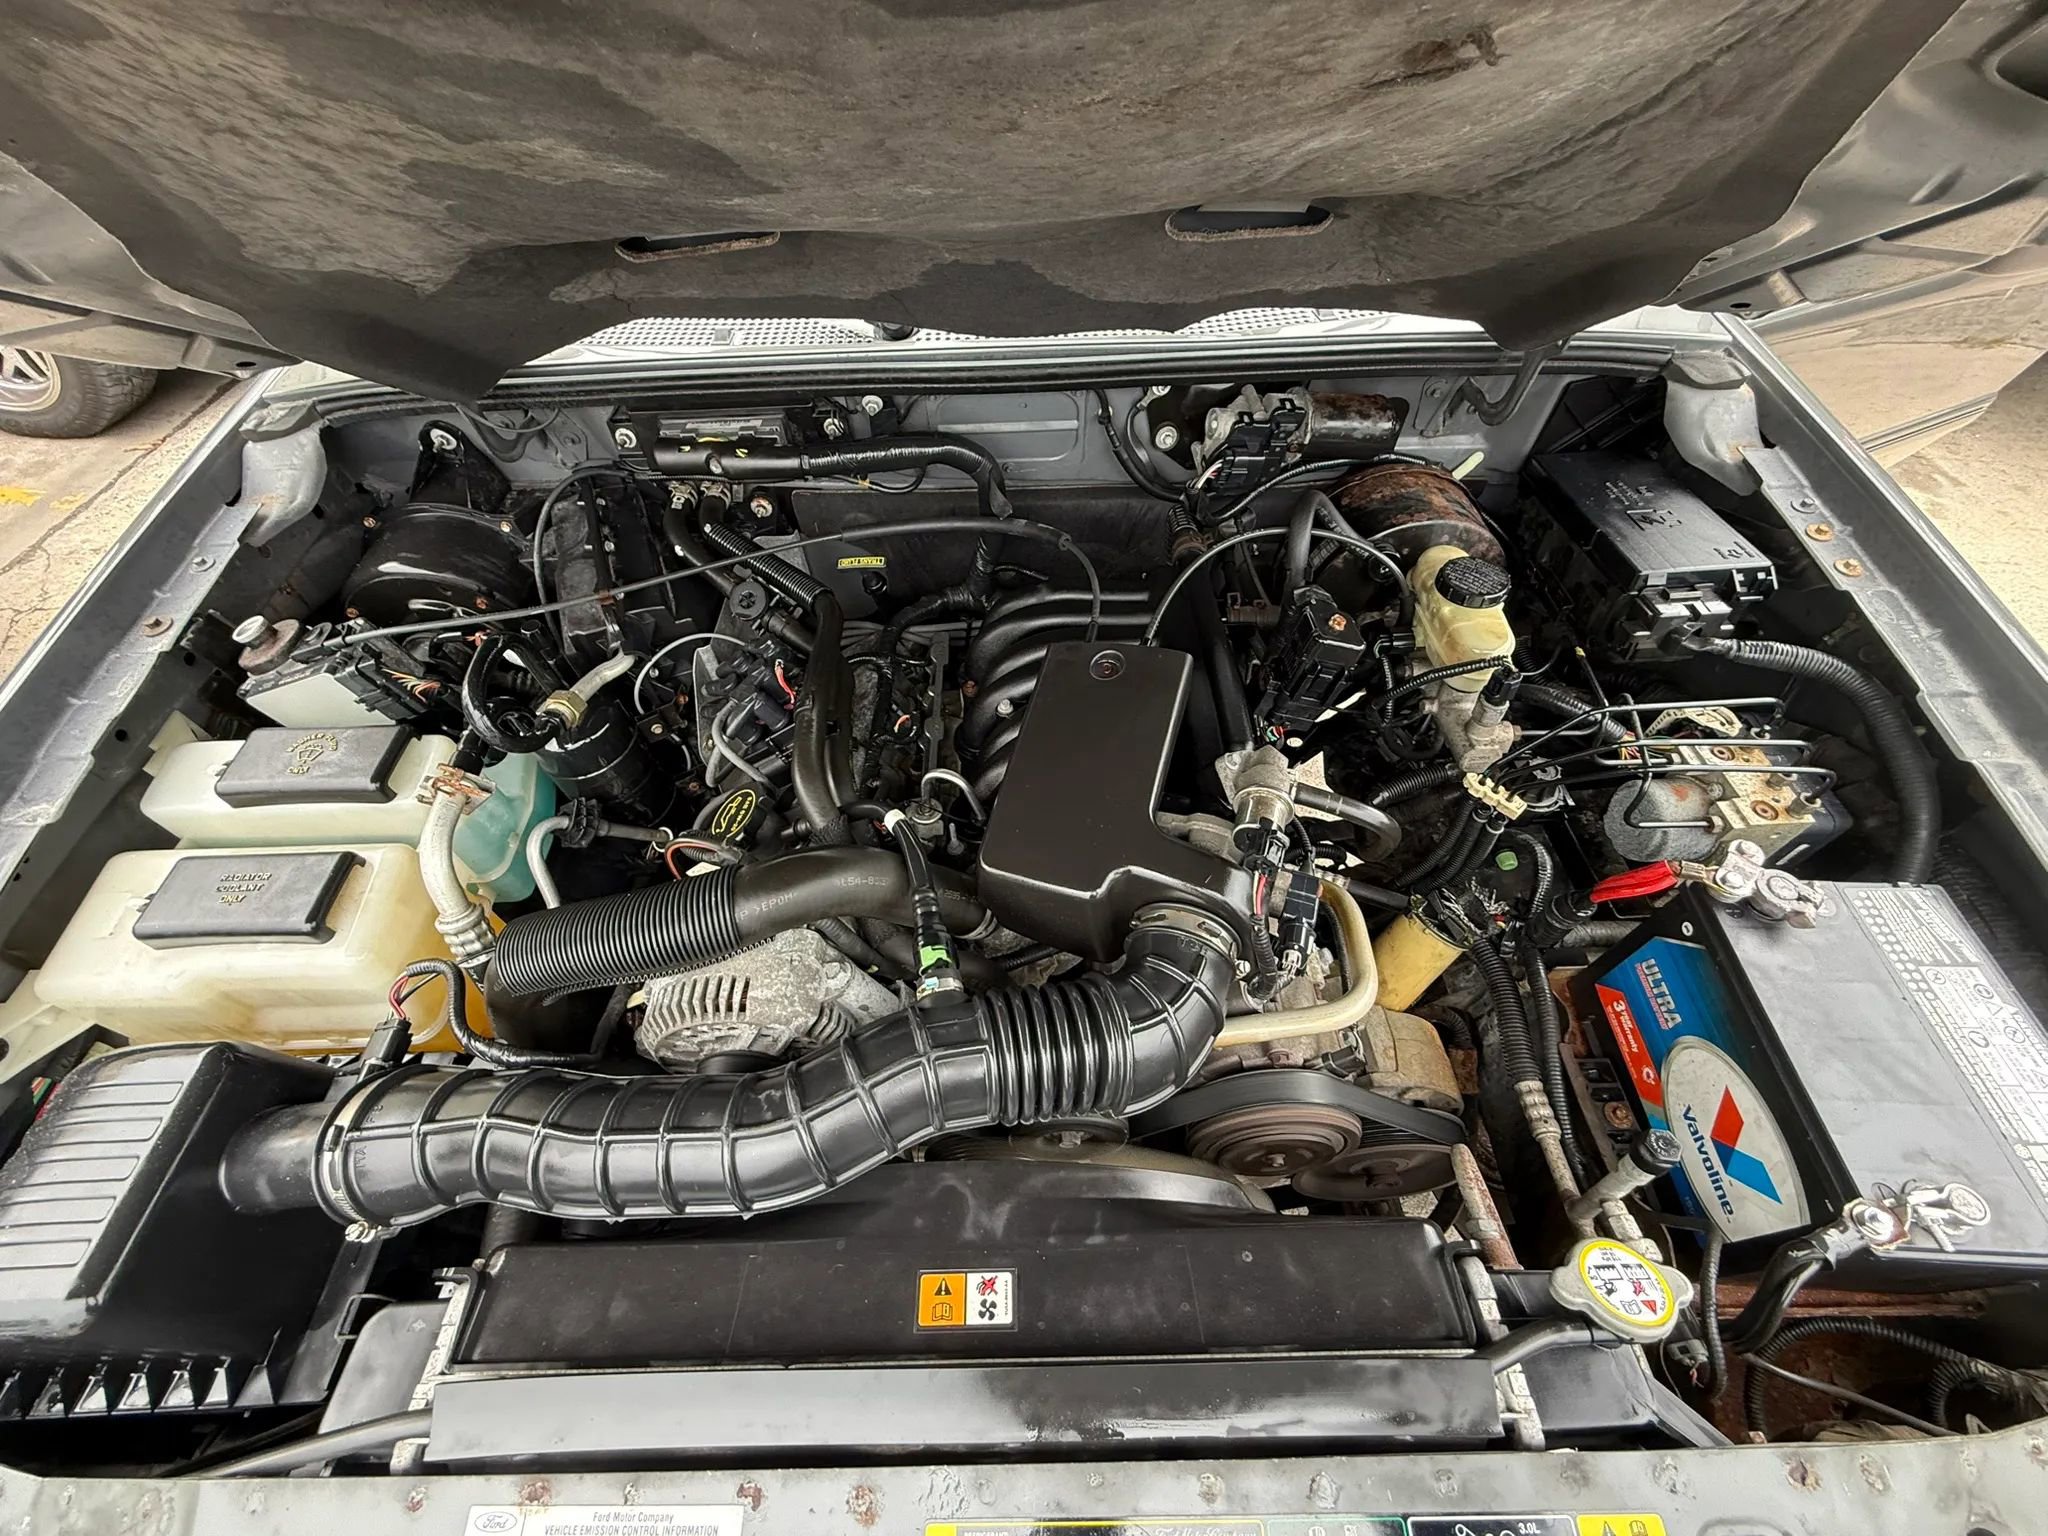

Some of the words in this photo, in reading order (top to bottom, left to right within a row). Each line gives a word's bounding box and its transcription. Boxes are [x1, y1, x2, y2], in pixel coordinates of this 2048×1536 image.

[219, 872, 272, 882] RADIATOR
[215, 883, 265, 893] COOLANT
[217, 894, 247, 904] ONLY
[1641, 958, 1683, 1029] ULTRA
[1612, 999, 1626, 1012] 3
[1619, 1015, 1639, 1053] warranty
[1680, 1104, 1734, 1216] Valvoline
[483, 1513, 509, 1530] Ford
[593, 1511, 611, 1522] Ford
[612, 1511, 636, 1522] Motor
[637, 1511, 675, 1524] Company
[544, 1524, 579, 1536] VEHICLE
[579, 1524, 620, 1536] EMISSION
[621, 1524, 660, 1536] CONTROL
[662, 1524, 719, 1536] INFORMATION
[1518, 1521, 1541, 1535] 3.0L
